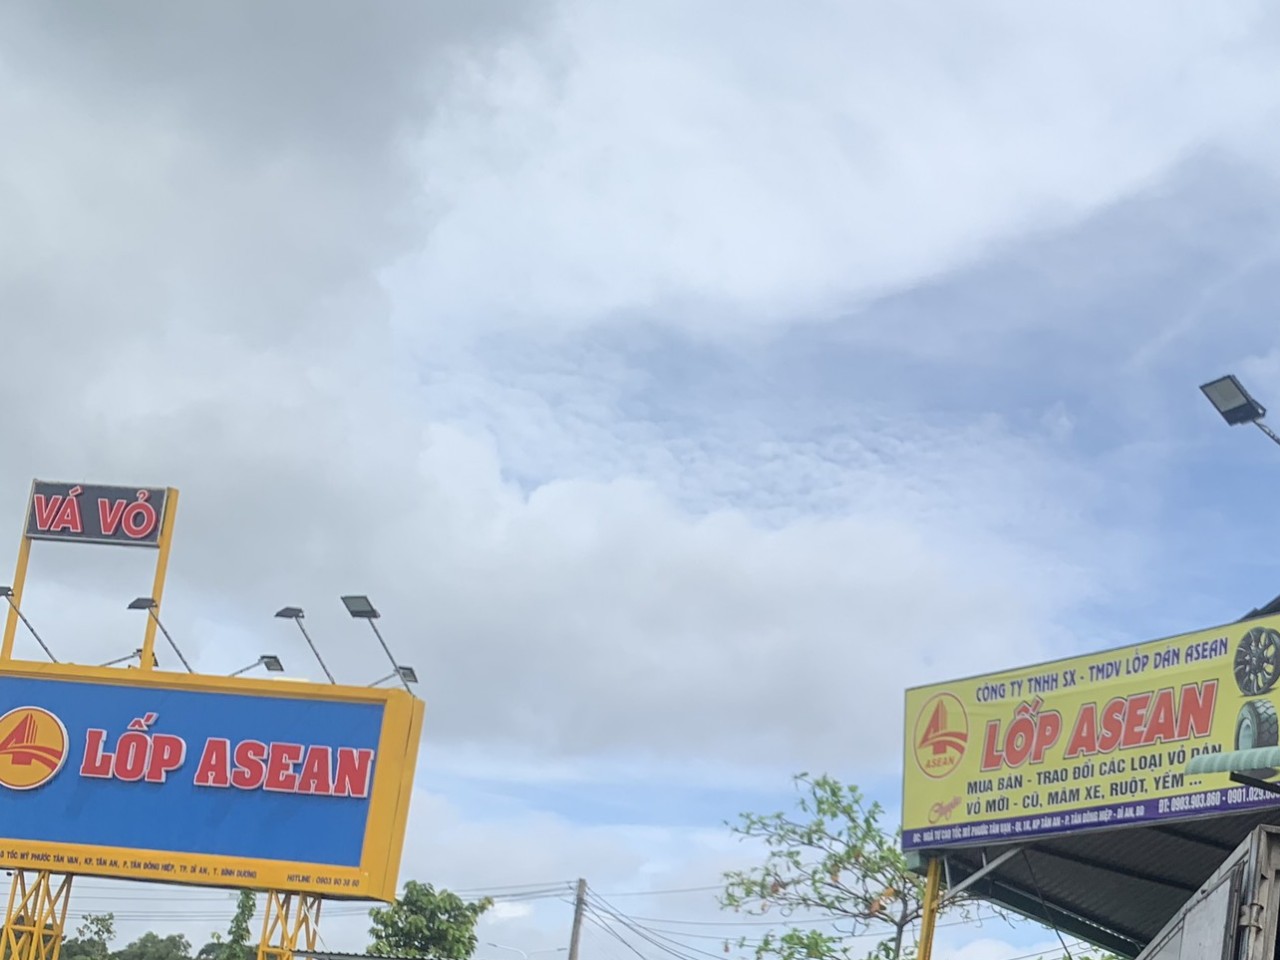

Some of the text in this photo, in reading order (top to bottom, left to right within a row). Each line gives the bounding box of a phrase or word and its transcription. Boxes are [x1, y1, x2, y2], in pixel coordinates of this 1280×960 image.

[34, 485, 157, 538] VÁ VỎ
[976, 682, 1005, 702] CÔNG
[1010, 680, 1022, 697] TY
[1028, 672, 1058, 694] TNHH
[1063, 669, 1076, 687] SX
[1089, 659, 1121, 682] TMDV
[1126, 647, 1149, 675] LỐP
[1154, 645, 1180, 669] DÁN
[1185, 637, 1228, 664] ASEAN
[980, 678, 1219, 772] LỐP ASEAN
[80, 712, 374, 798] LỐP ASEAN
[925, 756, 955, 769] ASEAN
[967, 780, 993, 795] MUA
[997, 772, 1023, 790] BÁN
[1036, 768, 1068, 785] TRAO
[1072, 758, 1094, 780] ĐỔI
[1099, 757, 1125, 776] CÁC
[1131, 753, 1162, 772] LOẠI
[1168, 744, 1186, 766] VỎ
[967, 797, 981, 816] VỎ
[986, 796, 1009, 813] MỚI
[1047, 787, 1080, 806] MÂM
[1154, 769, 1184, 791] YẾM
